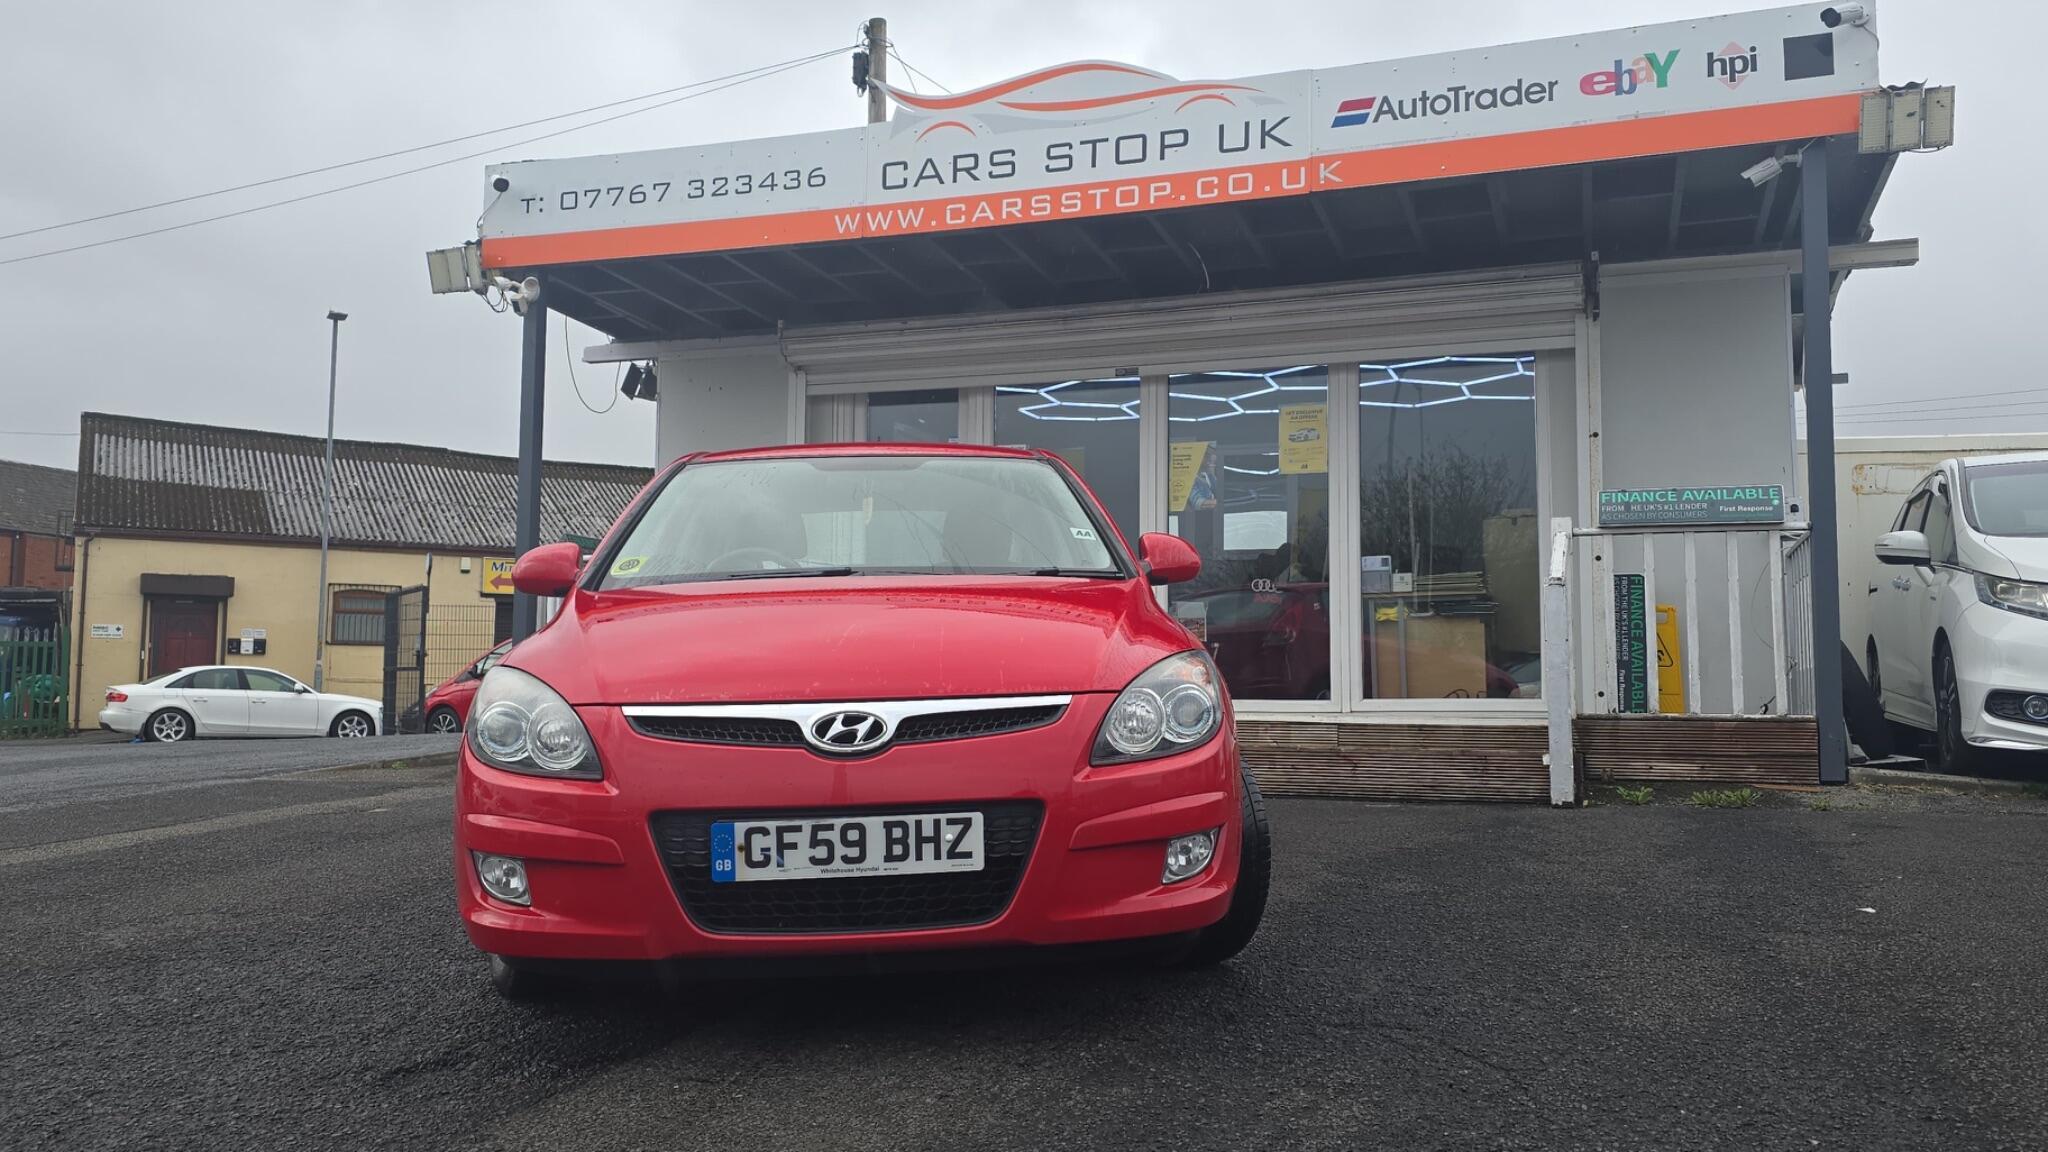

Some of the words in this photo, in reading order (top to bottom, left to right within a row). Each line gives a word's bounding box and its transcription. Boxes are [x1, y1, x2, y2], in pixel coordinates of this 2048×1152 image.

[1706, 44, 1759, 84] hpi
[1372, 77, 1558, 125] AutoTrader
[880, 148, 1016, 192] CARS
[1045, 128, 1190, 174] STOP
[1217, 115, 1294, 155] UK
[559, 181, 671, 212] 07767
[687, 165, 827, 201] 323436
[833, 159, 1345, 236] WWW.CARSSTOP.CO.UK
[1601, 491, 1677, 503] FINANCE
[1681, 487, 1779, 501] AVAILABLE
[1602, 504, 1625, 513] FROM
[1674, 502, 1707, 511] LENDER
[1719, 505, 1736, 513] First
[1737, 504, 1773, 513] Response
[1658, 510, 1707, 519] CONSUMERS
[1076, 530, 1092, 538] AA
[1630, 576, 1643, 637] FINANCE
[1621, 635, 1629, 661] LENDER
[1631, 640, 1644, 713] AVAILABLE
[743, 822, 867, 871] GF59
[883, 816, 975, 864] BHZ
[715, 859, 733, 872] GB
[855, 865, 880, 874] Hyundai
